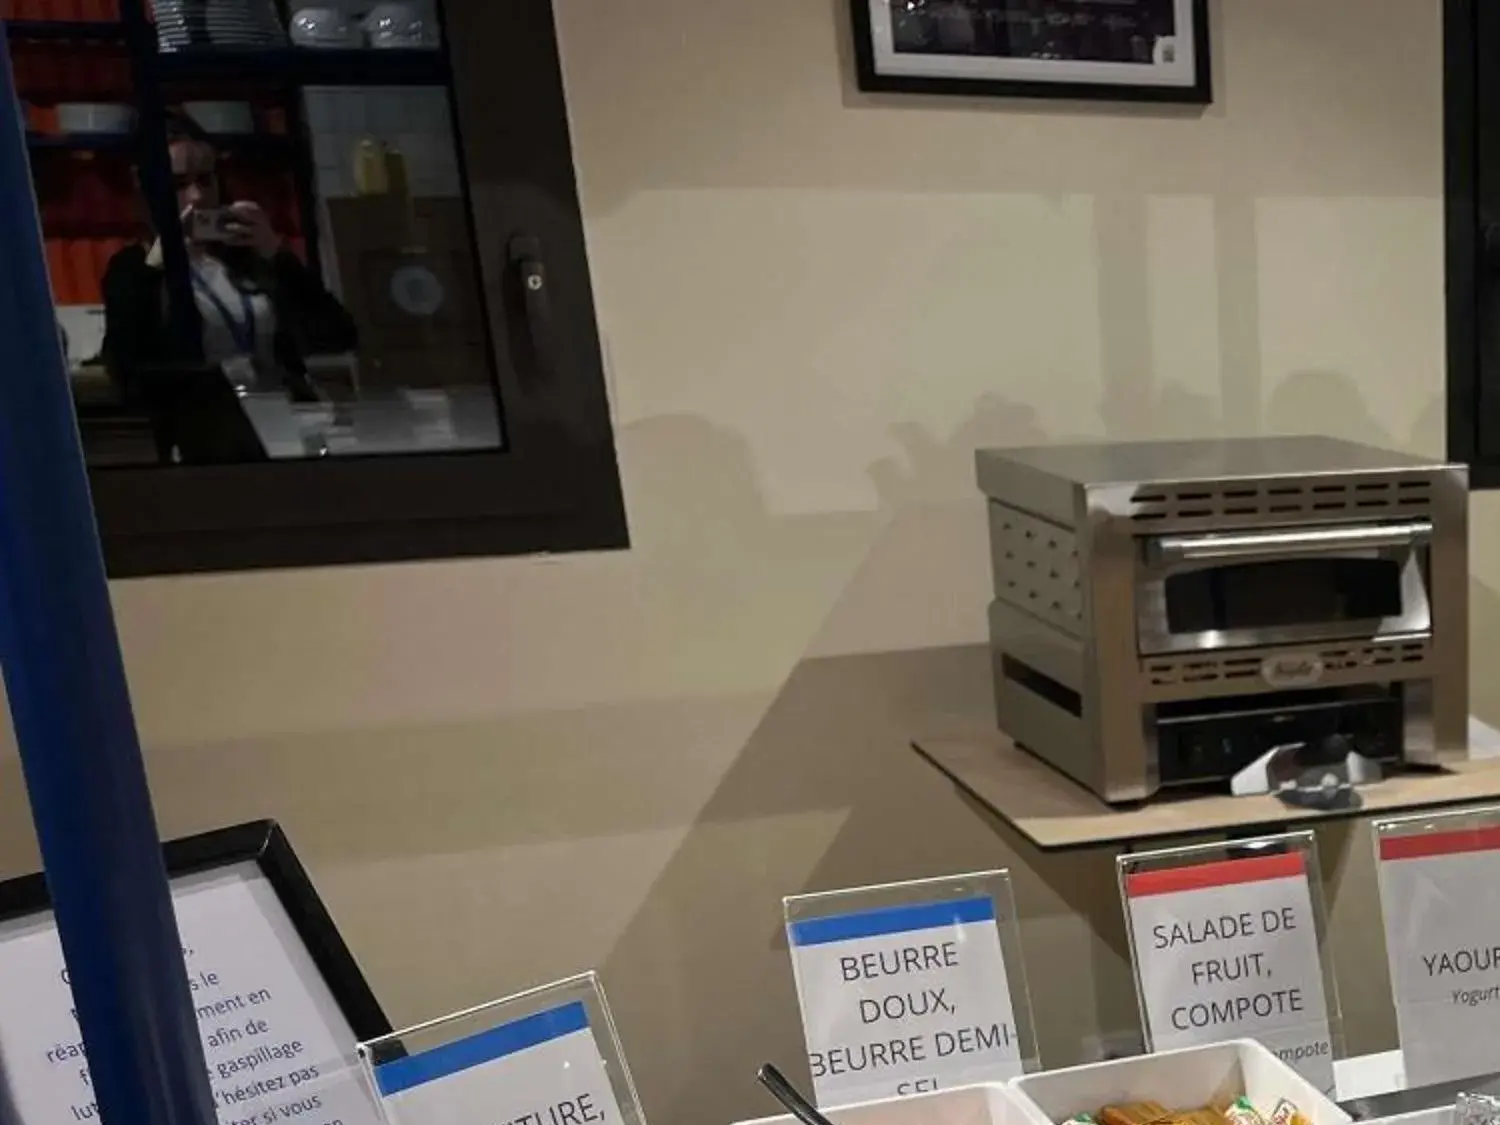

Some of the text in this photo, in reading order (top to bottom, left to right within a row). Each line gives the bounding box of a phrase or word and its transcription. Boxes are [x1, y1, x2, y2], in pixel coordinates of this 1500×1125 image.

[1153, 907, 1297, 949] SALADE DE
[840, 941, 959, 982] BEURRE
[1191, 953, 1272, 985] FRUIT,
[200, 971, 220, 988] le
[248, 988, 272, 1005] en
[859, 988, 956, 1024] DOUX,
[1171, 989, 1304, 1031] COMPOTE
[1452, 985, 1500, 1007] Yogurt
[207, 1019, 270, 1048] afin de
[217, 1040, 304, 1080] gaspillage
[809, 1037, 926, 1078] BEURRE
[289, 1065, 319, 1087] pas
[263, 1106, 278, 1125] si
[279, 1095, 322, 1118] vous
